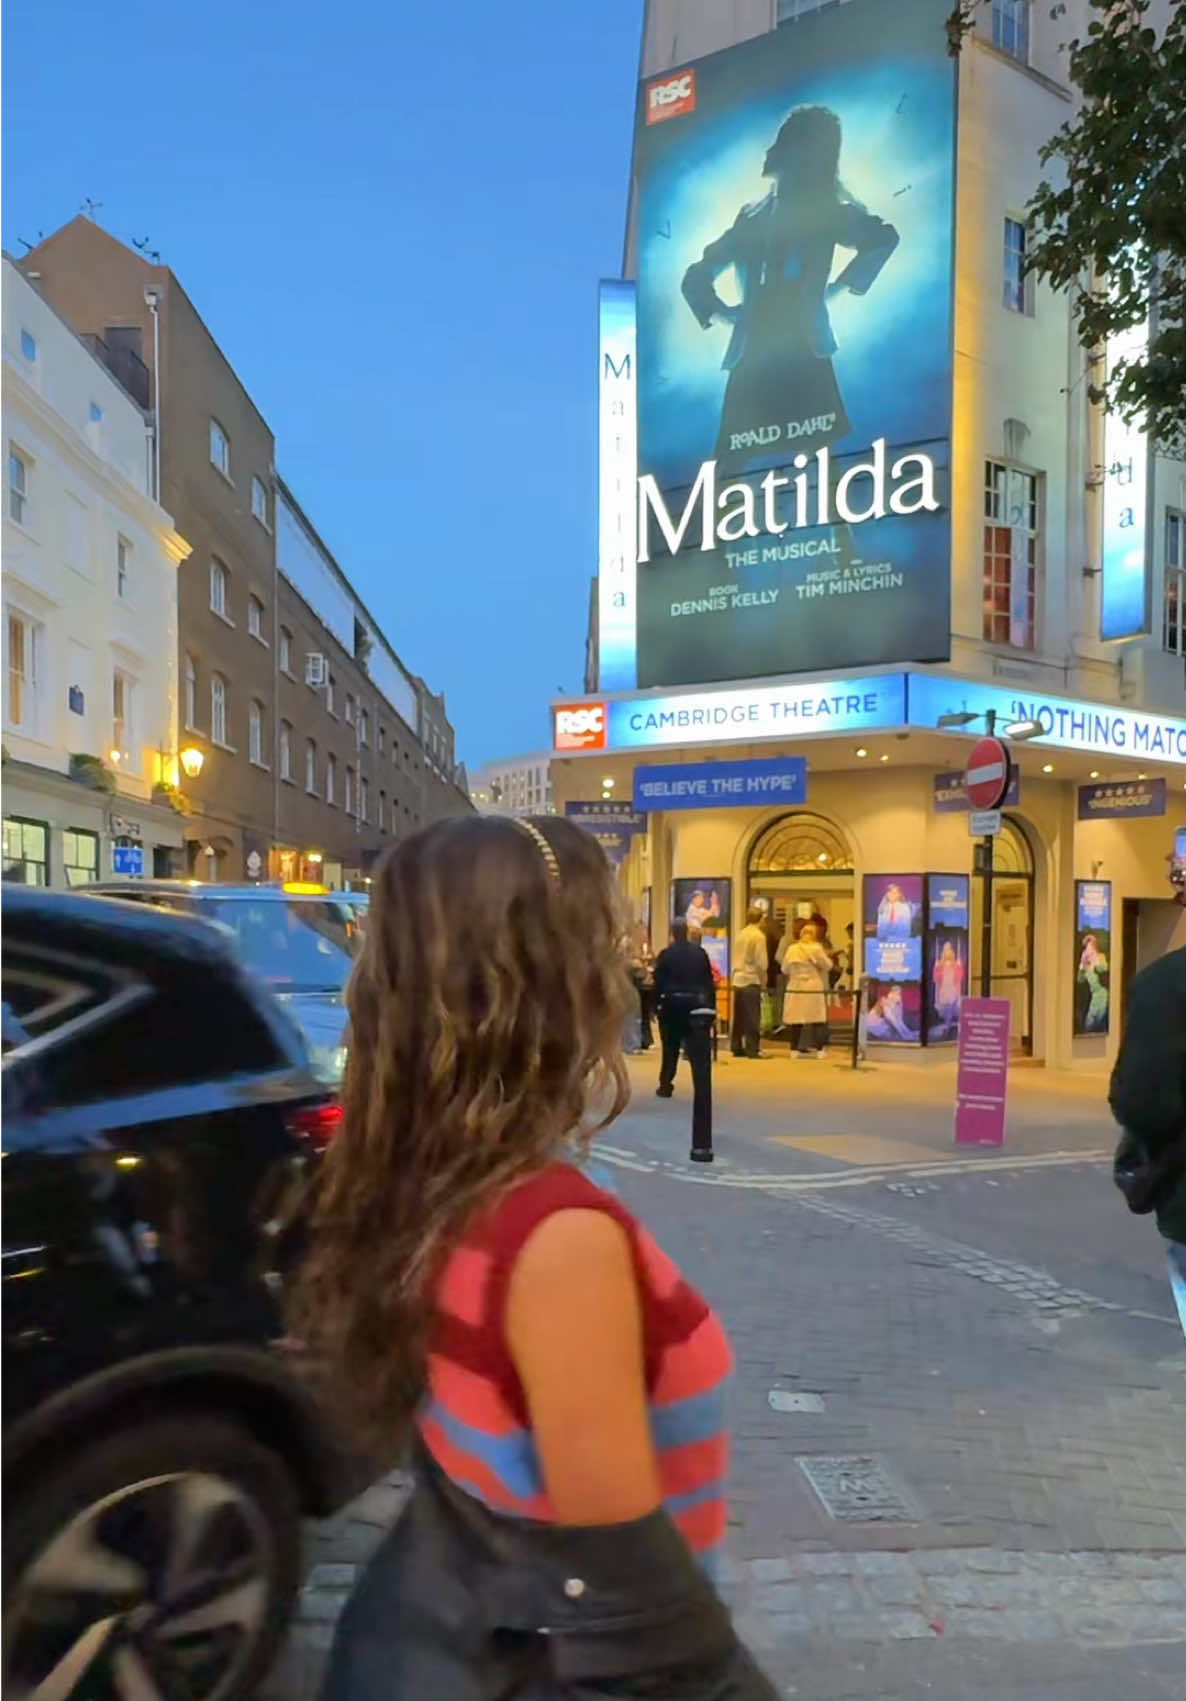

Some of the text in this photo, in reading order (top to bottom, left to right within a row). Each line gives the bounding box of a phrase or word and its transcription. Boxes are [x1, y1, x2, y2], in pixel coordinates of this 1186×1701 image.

[649, 76, 692, 108] RSC
[729, 424, 781, 450] ROALD
[637, 439, 939, 563] Matilda
[726, 539, 842, 568] THE MUSICAL
[796, 573, 903, 600] TIM MINCHIN
[670, 589, 779, 617] DENNIS KELLY
[556, 708, 602, 734] RSC
[630, 693, 878, 731] CAMBRIDGE THEATRE
[640, 774, 796, 797] 'BELIEVE THE HYPE'
